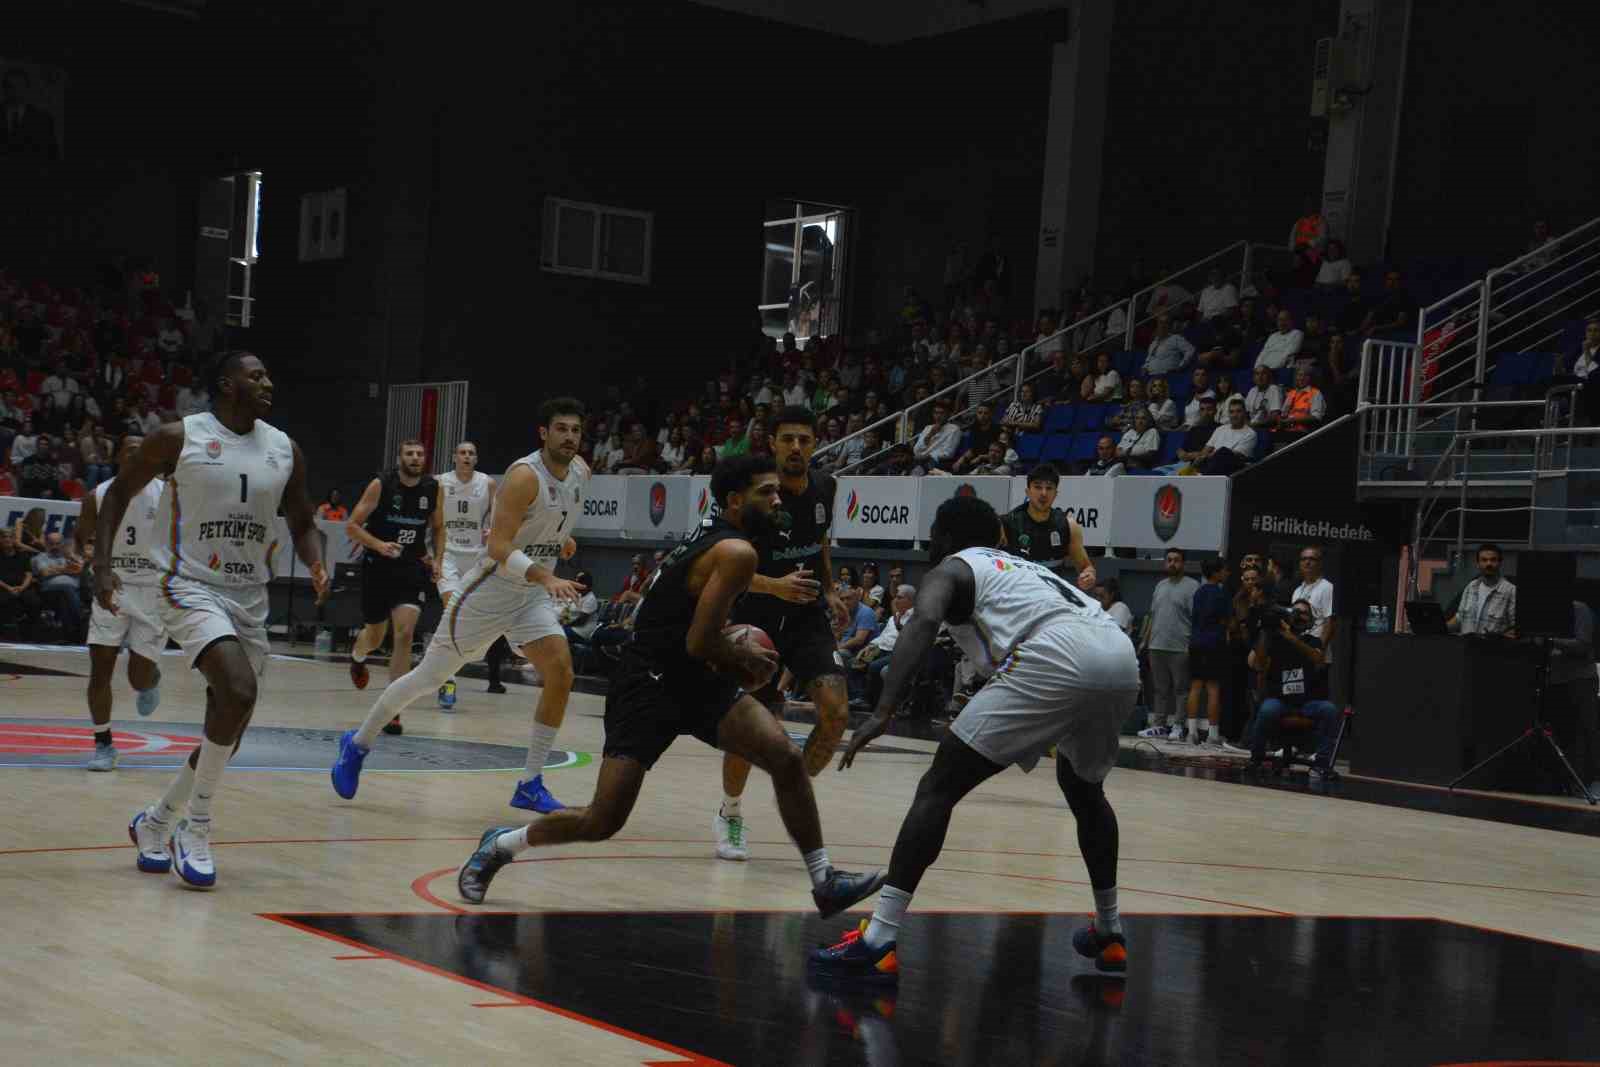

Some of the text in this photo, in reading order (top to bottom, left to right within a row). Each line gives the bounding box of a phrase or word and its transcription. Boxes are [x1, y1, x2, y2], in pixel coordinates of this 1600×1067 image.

[239, 474, 248, 503] 1
[583, 499, 618, 516] SOCAR
[861, 505, 909, 524] SOCAR
[126, 526, 136, 546] 3
[199, 519, 245, 541] PETKİM
[397, 529, 417, 544] 22
